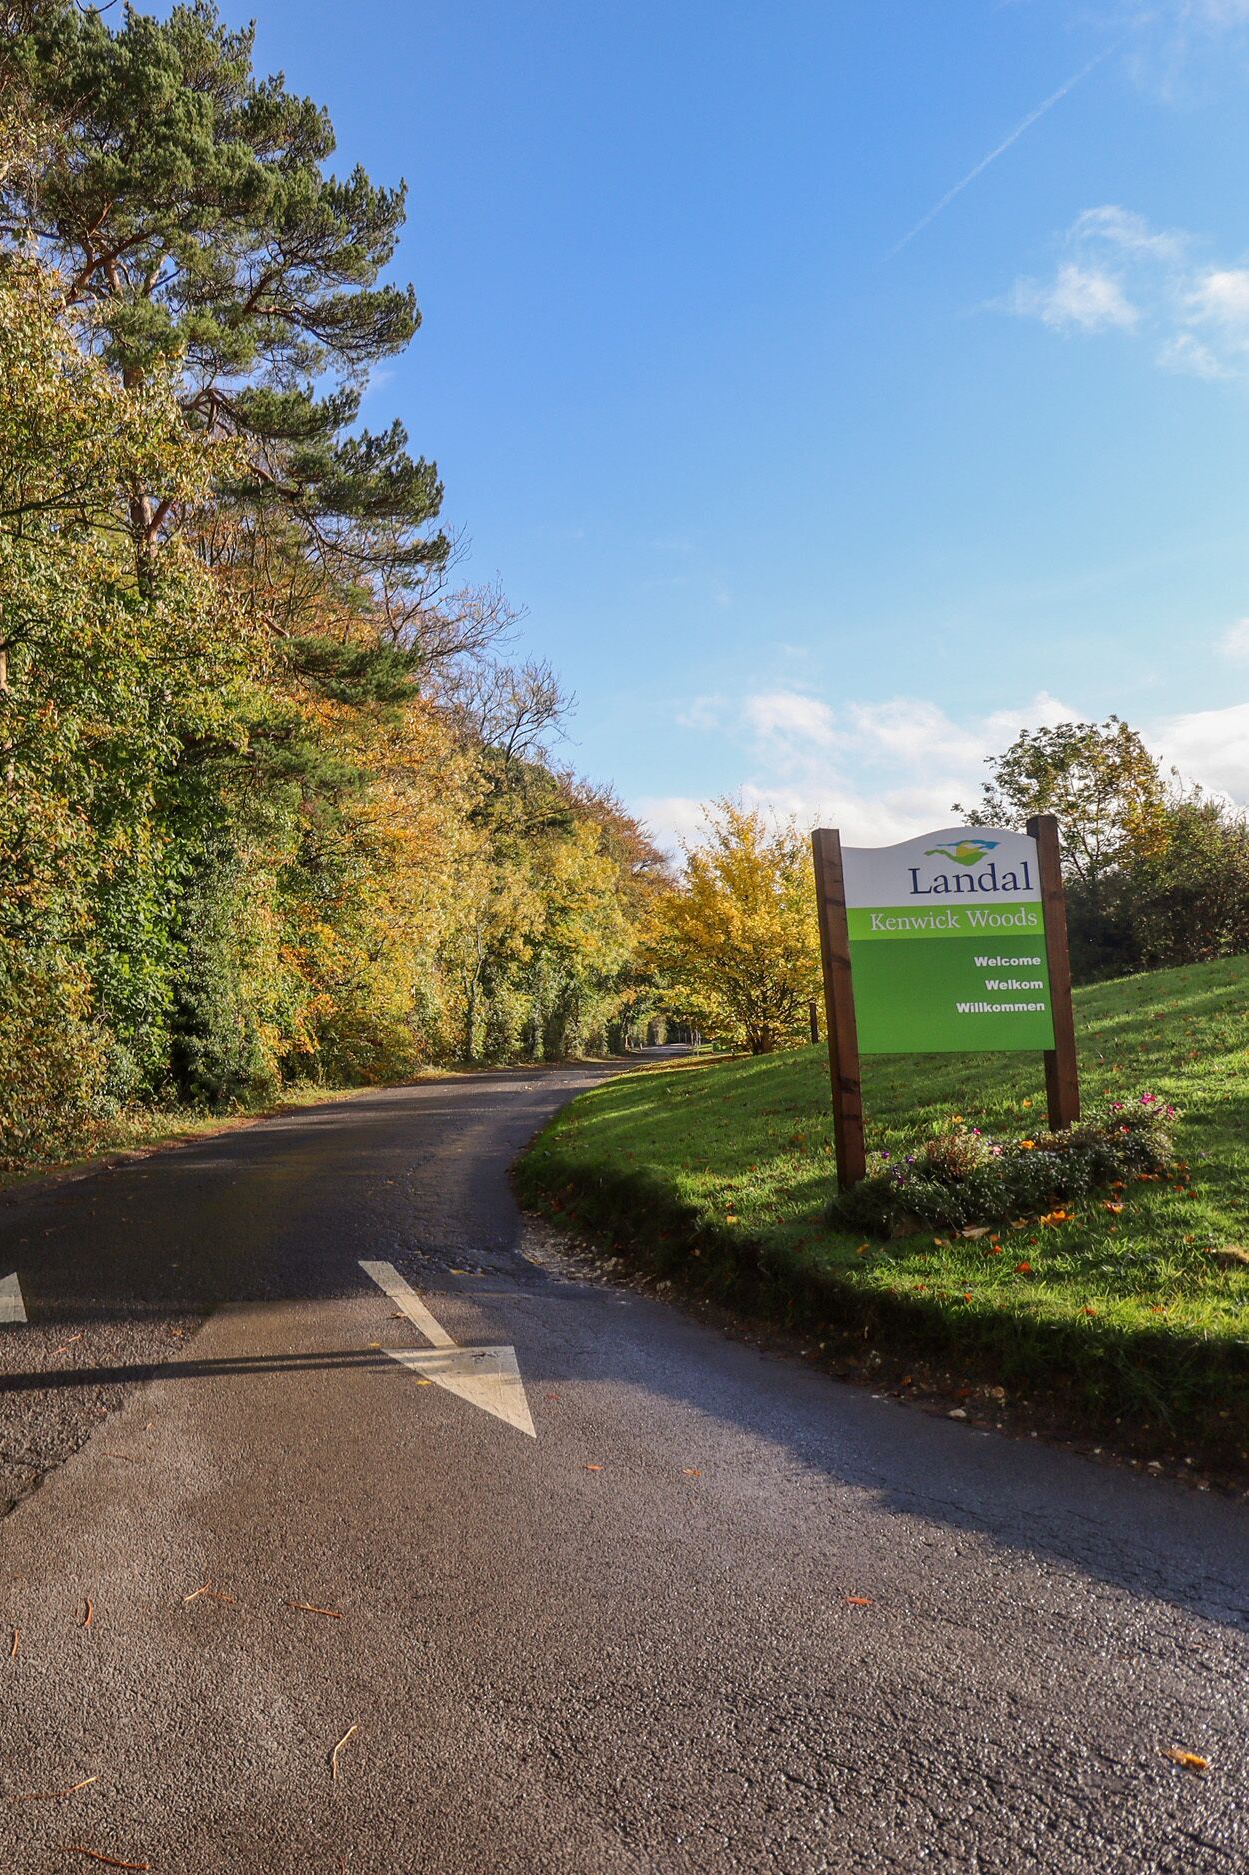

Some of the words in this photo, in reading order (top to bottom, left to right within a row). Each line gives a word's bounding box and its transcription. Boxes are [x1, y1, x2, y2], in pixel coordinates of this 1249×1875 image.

[908, 861, 1034, 895] Landal
[870, 909, 960, 932] Kenwick
[966, 907, 1038, 927] Woods
[974, 956, 1041, 967] Welcome
[985, 979, 1043, 990] Welkom
[956, 1002, 1045, 1013] Willkommen
